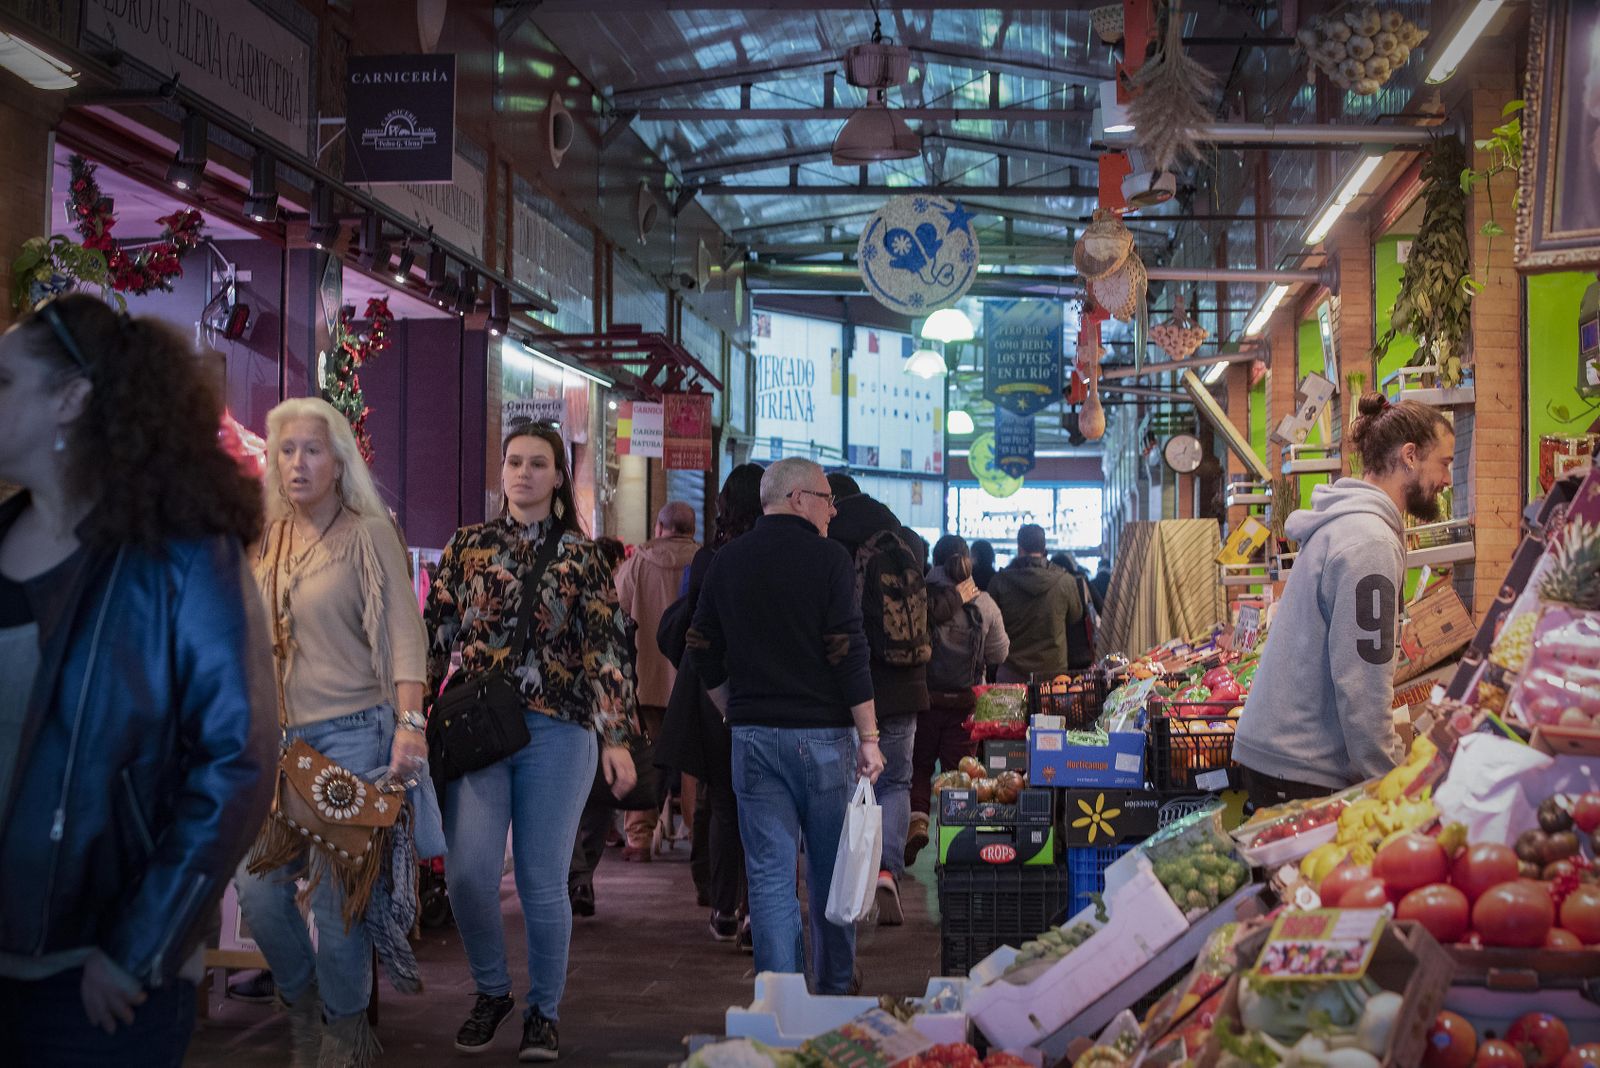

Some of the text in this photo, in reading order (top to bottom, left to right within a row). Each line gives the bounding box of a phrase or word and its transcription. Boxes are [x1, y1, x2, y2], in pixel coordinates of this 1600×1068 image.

[177, 0, 223, 80] ELENA
[226, 31, 303, 129] CARNICERÍA
[351, 68, 448, 84] CARNICERÍA
[997, 352, 1051, 365] LOS PECES
[997, 367, 1012, 379] EN
[1015, 367, 1028, 379] EL
[633, 406, 663, 414] CARNIC
[1356, 574, 1396, 665] 9
[981, 843, 1015, 860] TROPS
